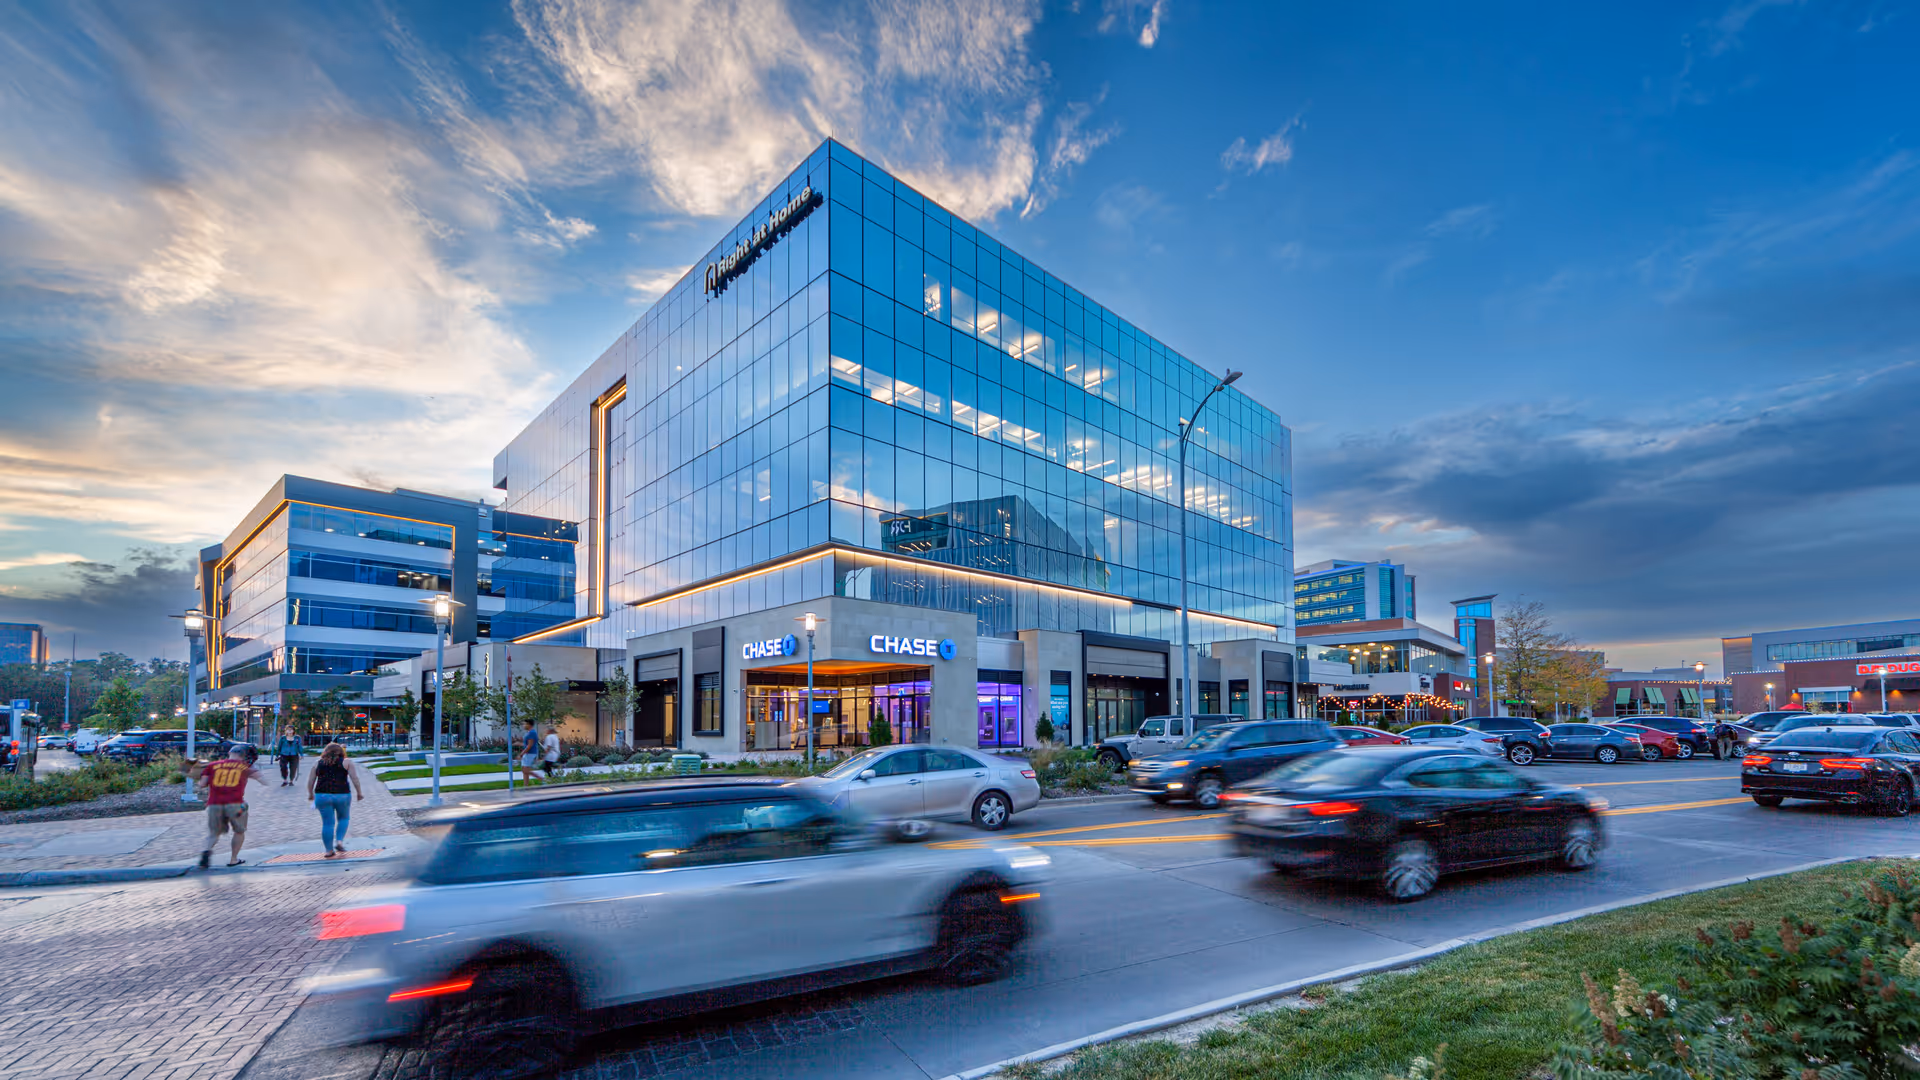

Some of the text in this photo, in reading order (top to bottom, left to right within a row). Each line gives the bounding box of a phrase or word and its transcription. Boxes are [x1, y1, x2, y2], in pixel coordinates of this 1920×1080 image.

[718, 186, 812, 279] Right at Home
[742, 639, 782, 660] CHASE
[870, 634, 938, 657] CHASE
